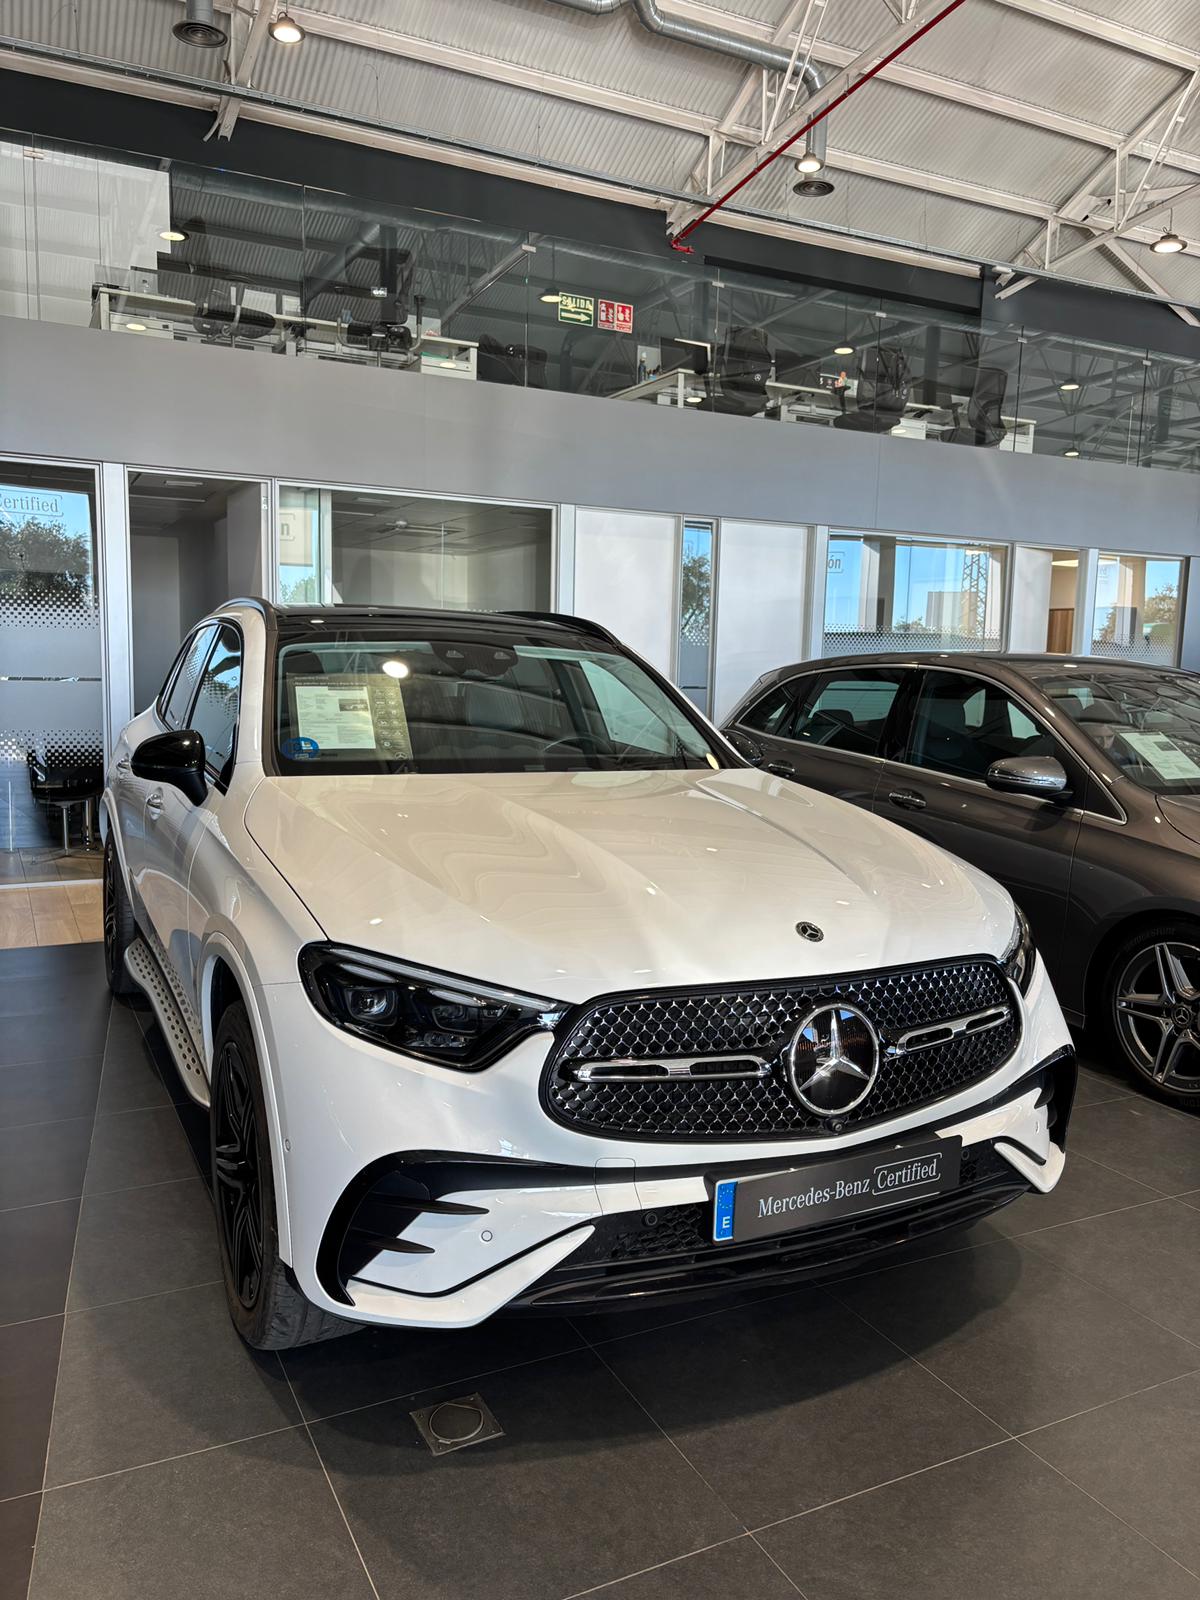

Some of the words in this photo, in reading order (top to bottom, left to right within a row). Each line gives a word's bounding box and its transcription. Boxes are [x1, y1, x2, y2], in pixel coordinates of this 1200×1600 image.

[561, 295, 593, 311] SALIDA
[0, 494, 58, 512] ertified
[757, 1178, 870, 1218] Mercedes-Benz
[877, 1158, 937, 1189] Certified
[722, 1216, 731, 1229] E
